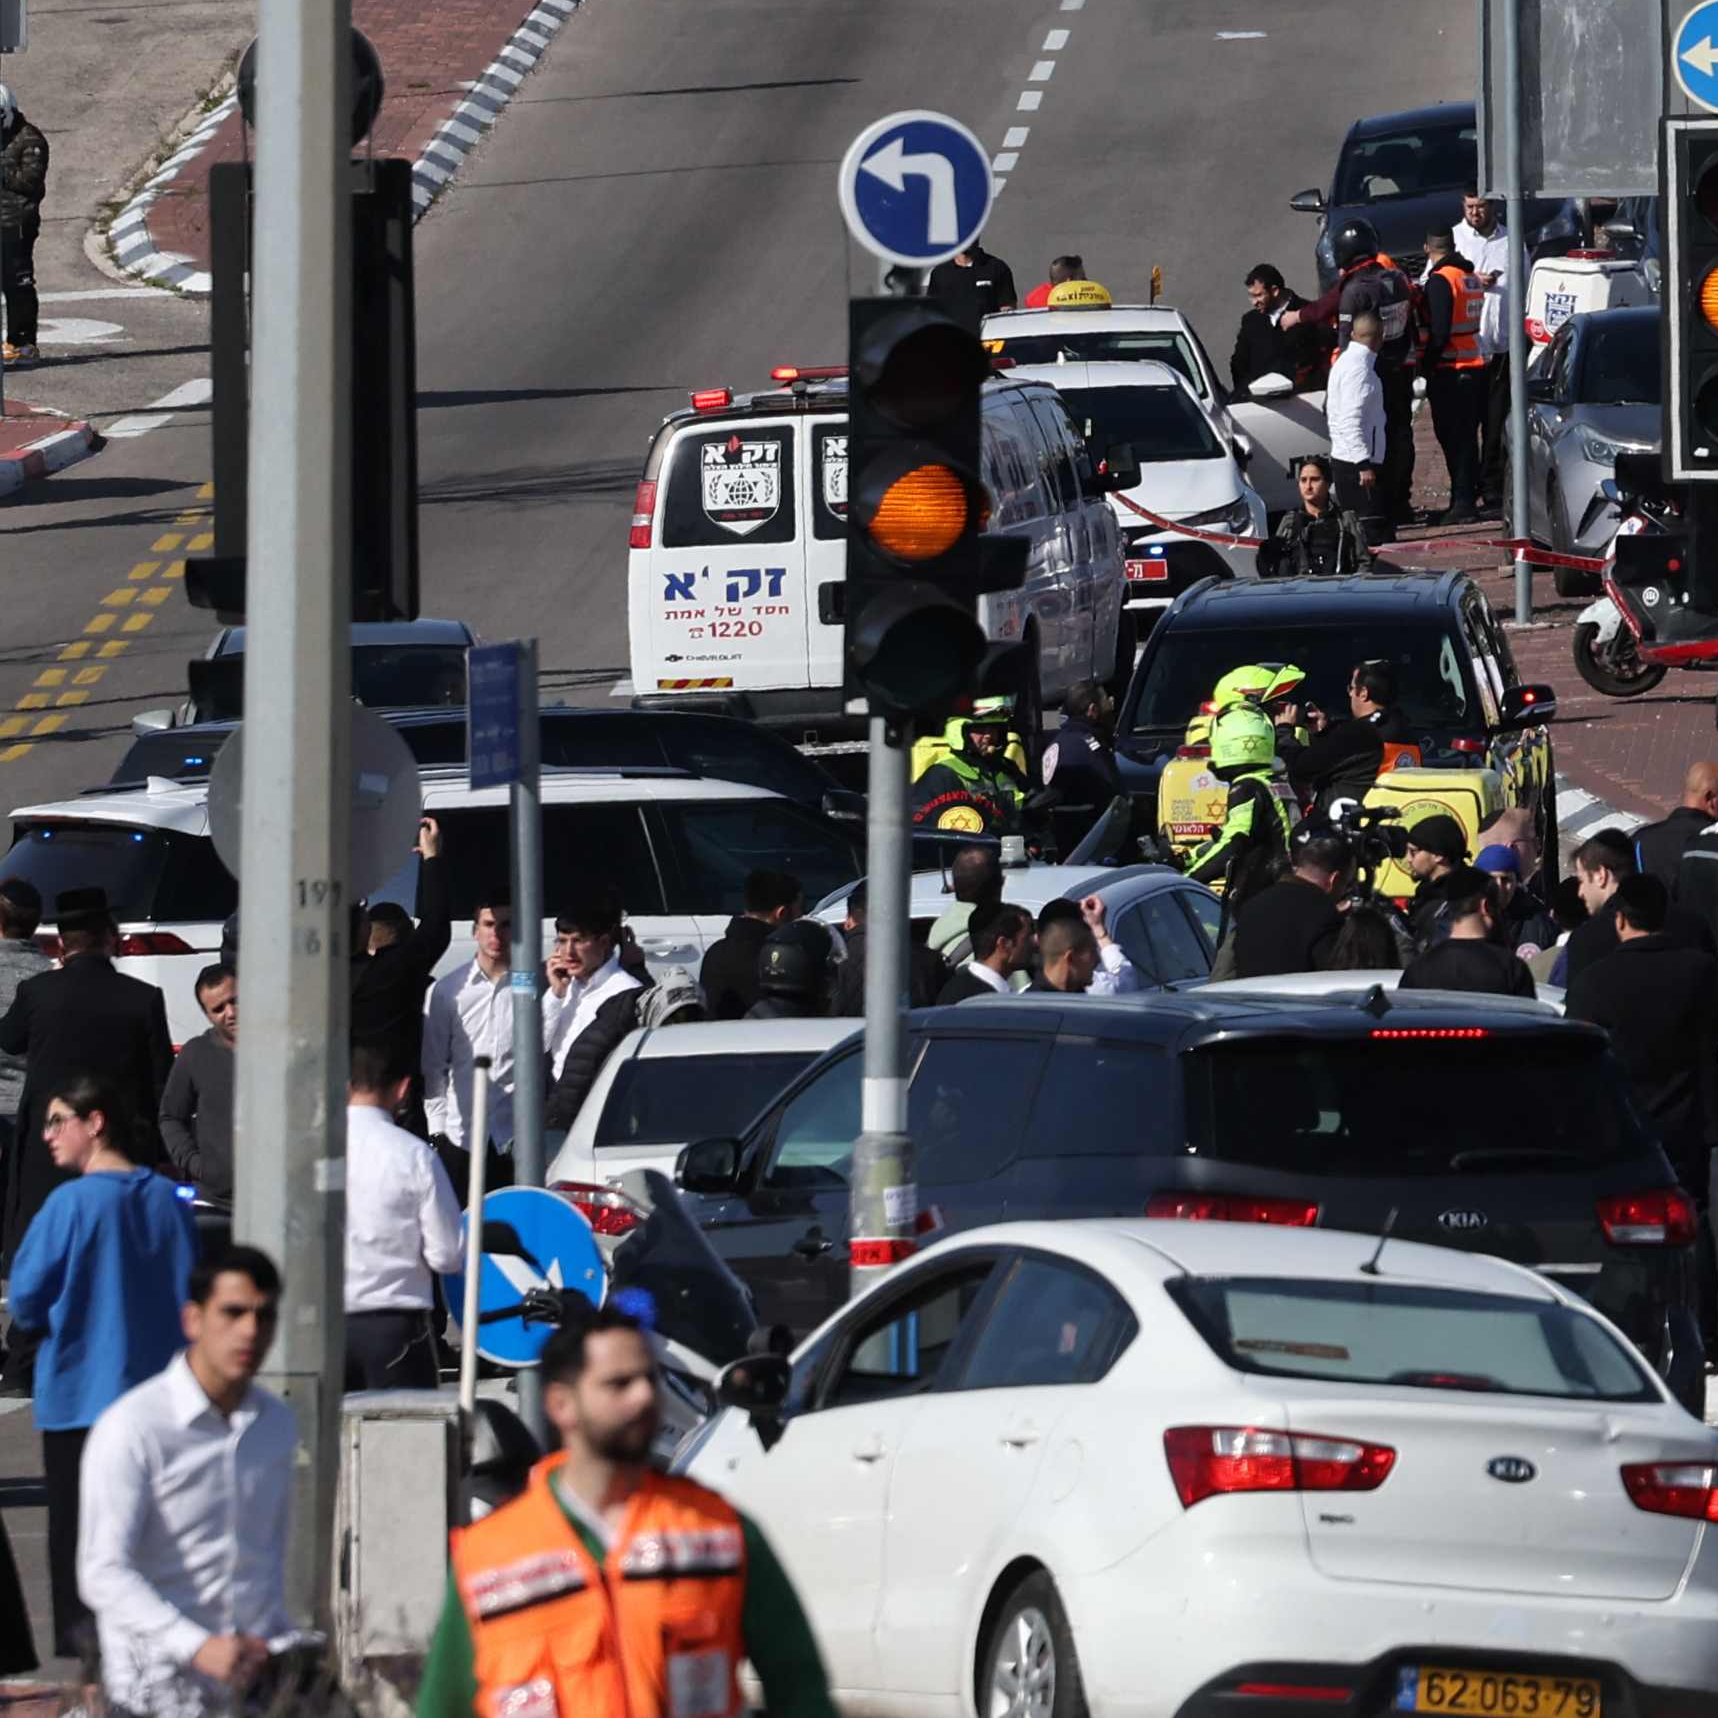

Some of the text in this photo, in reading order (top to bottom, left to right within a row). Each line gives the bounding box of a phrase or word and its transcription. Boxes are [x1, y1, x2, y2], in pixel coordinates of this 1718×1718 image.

[664, 605, 790, 621] חסד של אמת
[707, 620, 763, 639] 1220
[1447, 1211, 1481, 1228] KIA
[1494, 1460, 1530, 1478] KIA
